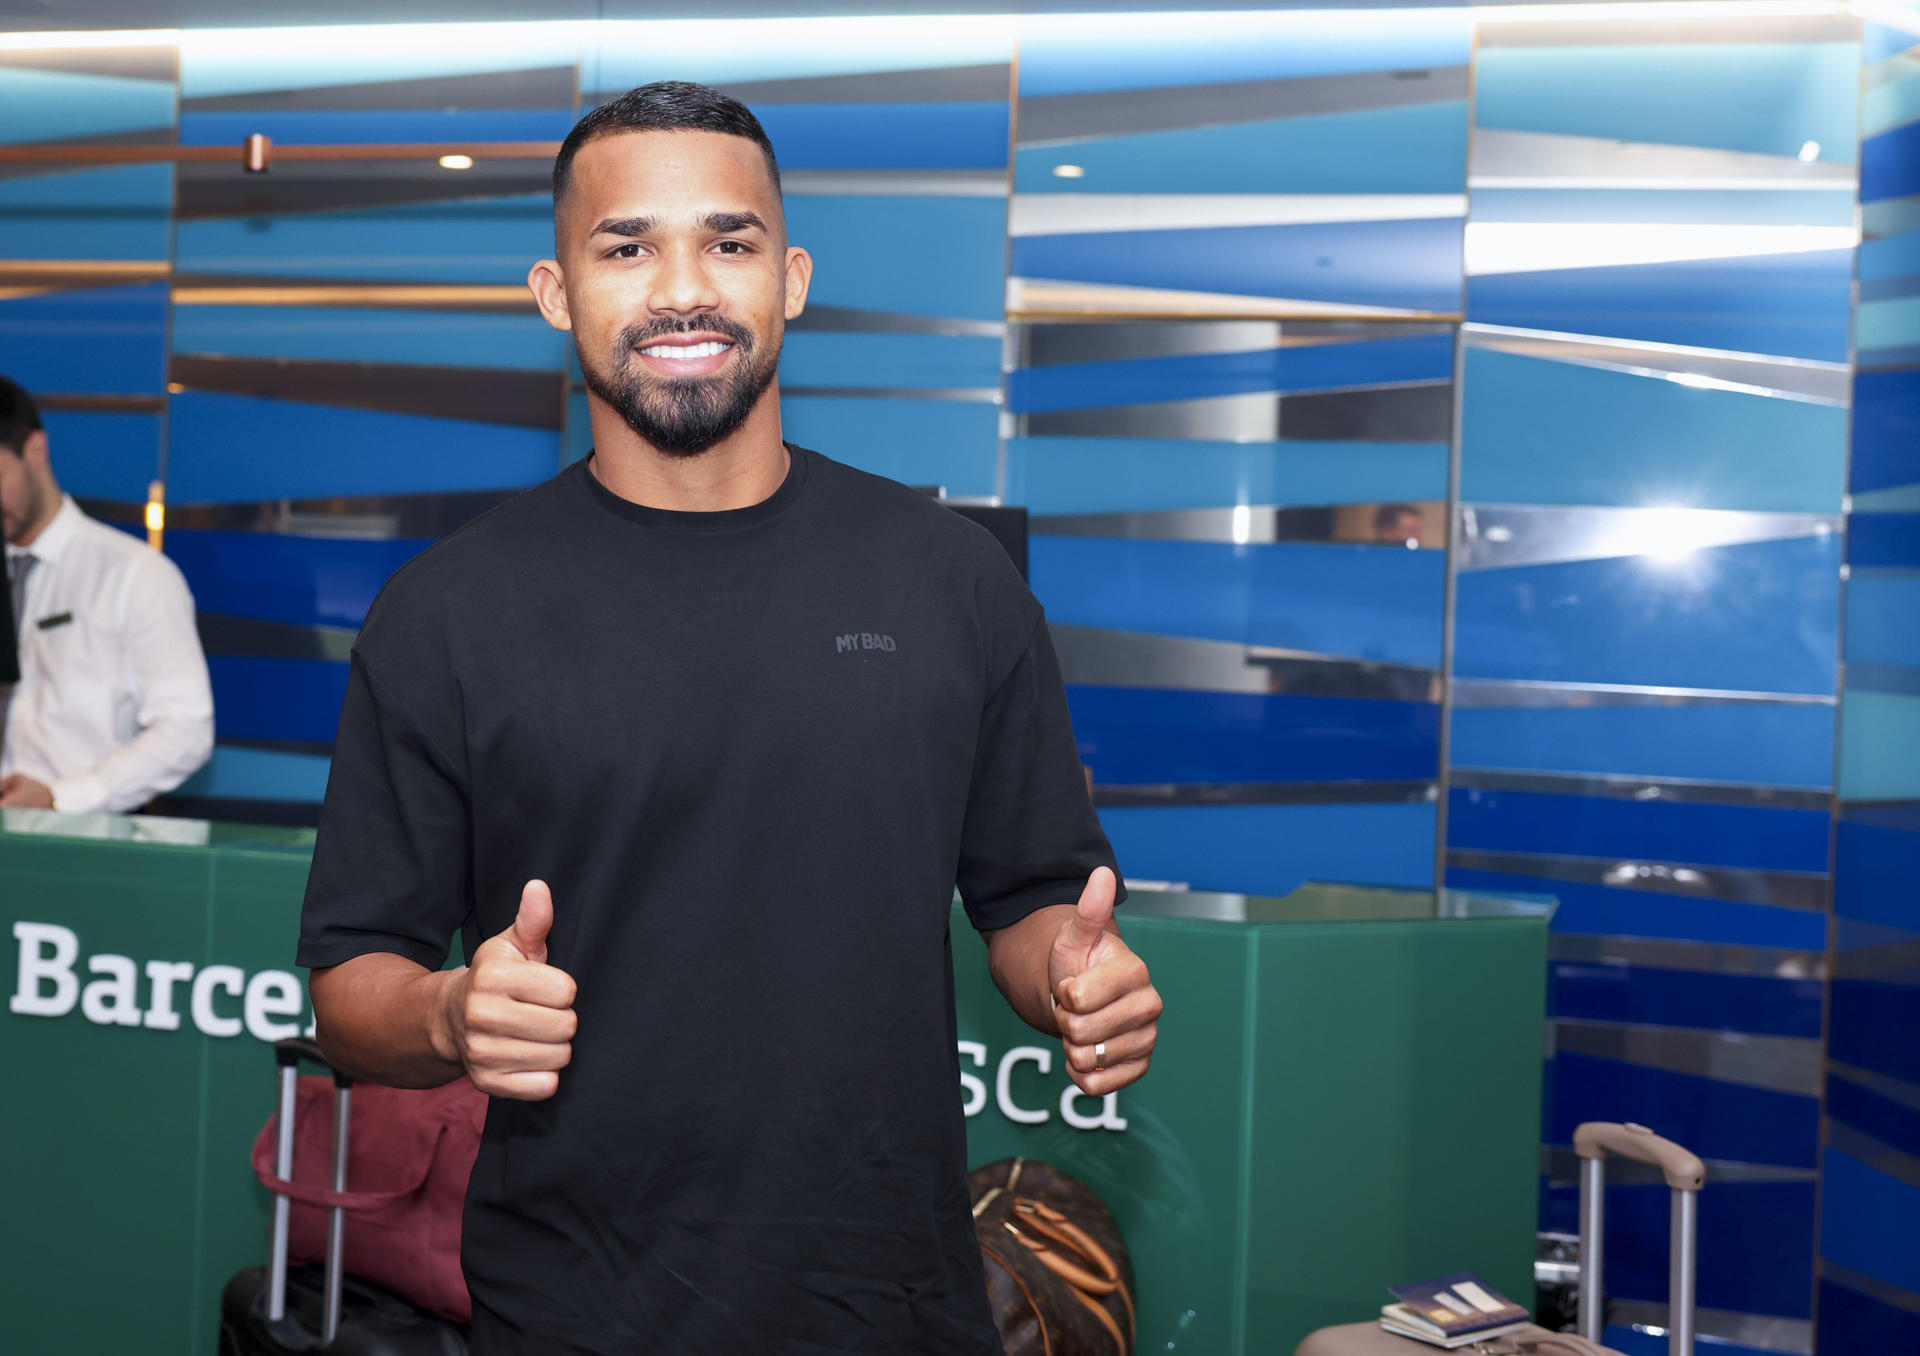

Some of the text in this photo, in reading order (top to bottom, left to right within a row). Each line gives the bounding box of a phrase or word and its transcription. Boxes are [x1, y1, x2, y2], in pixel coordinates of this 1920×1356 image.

[836, 632, 896, 653] MY BAD
[9, 920, 317, 1042] Barce
